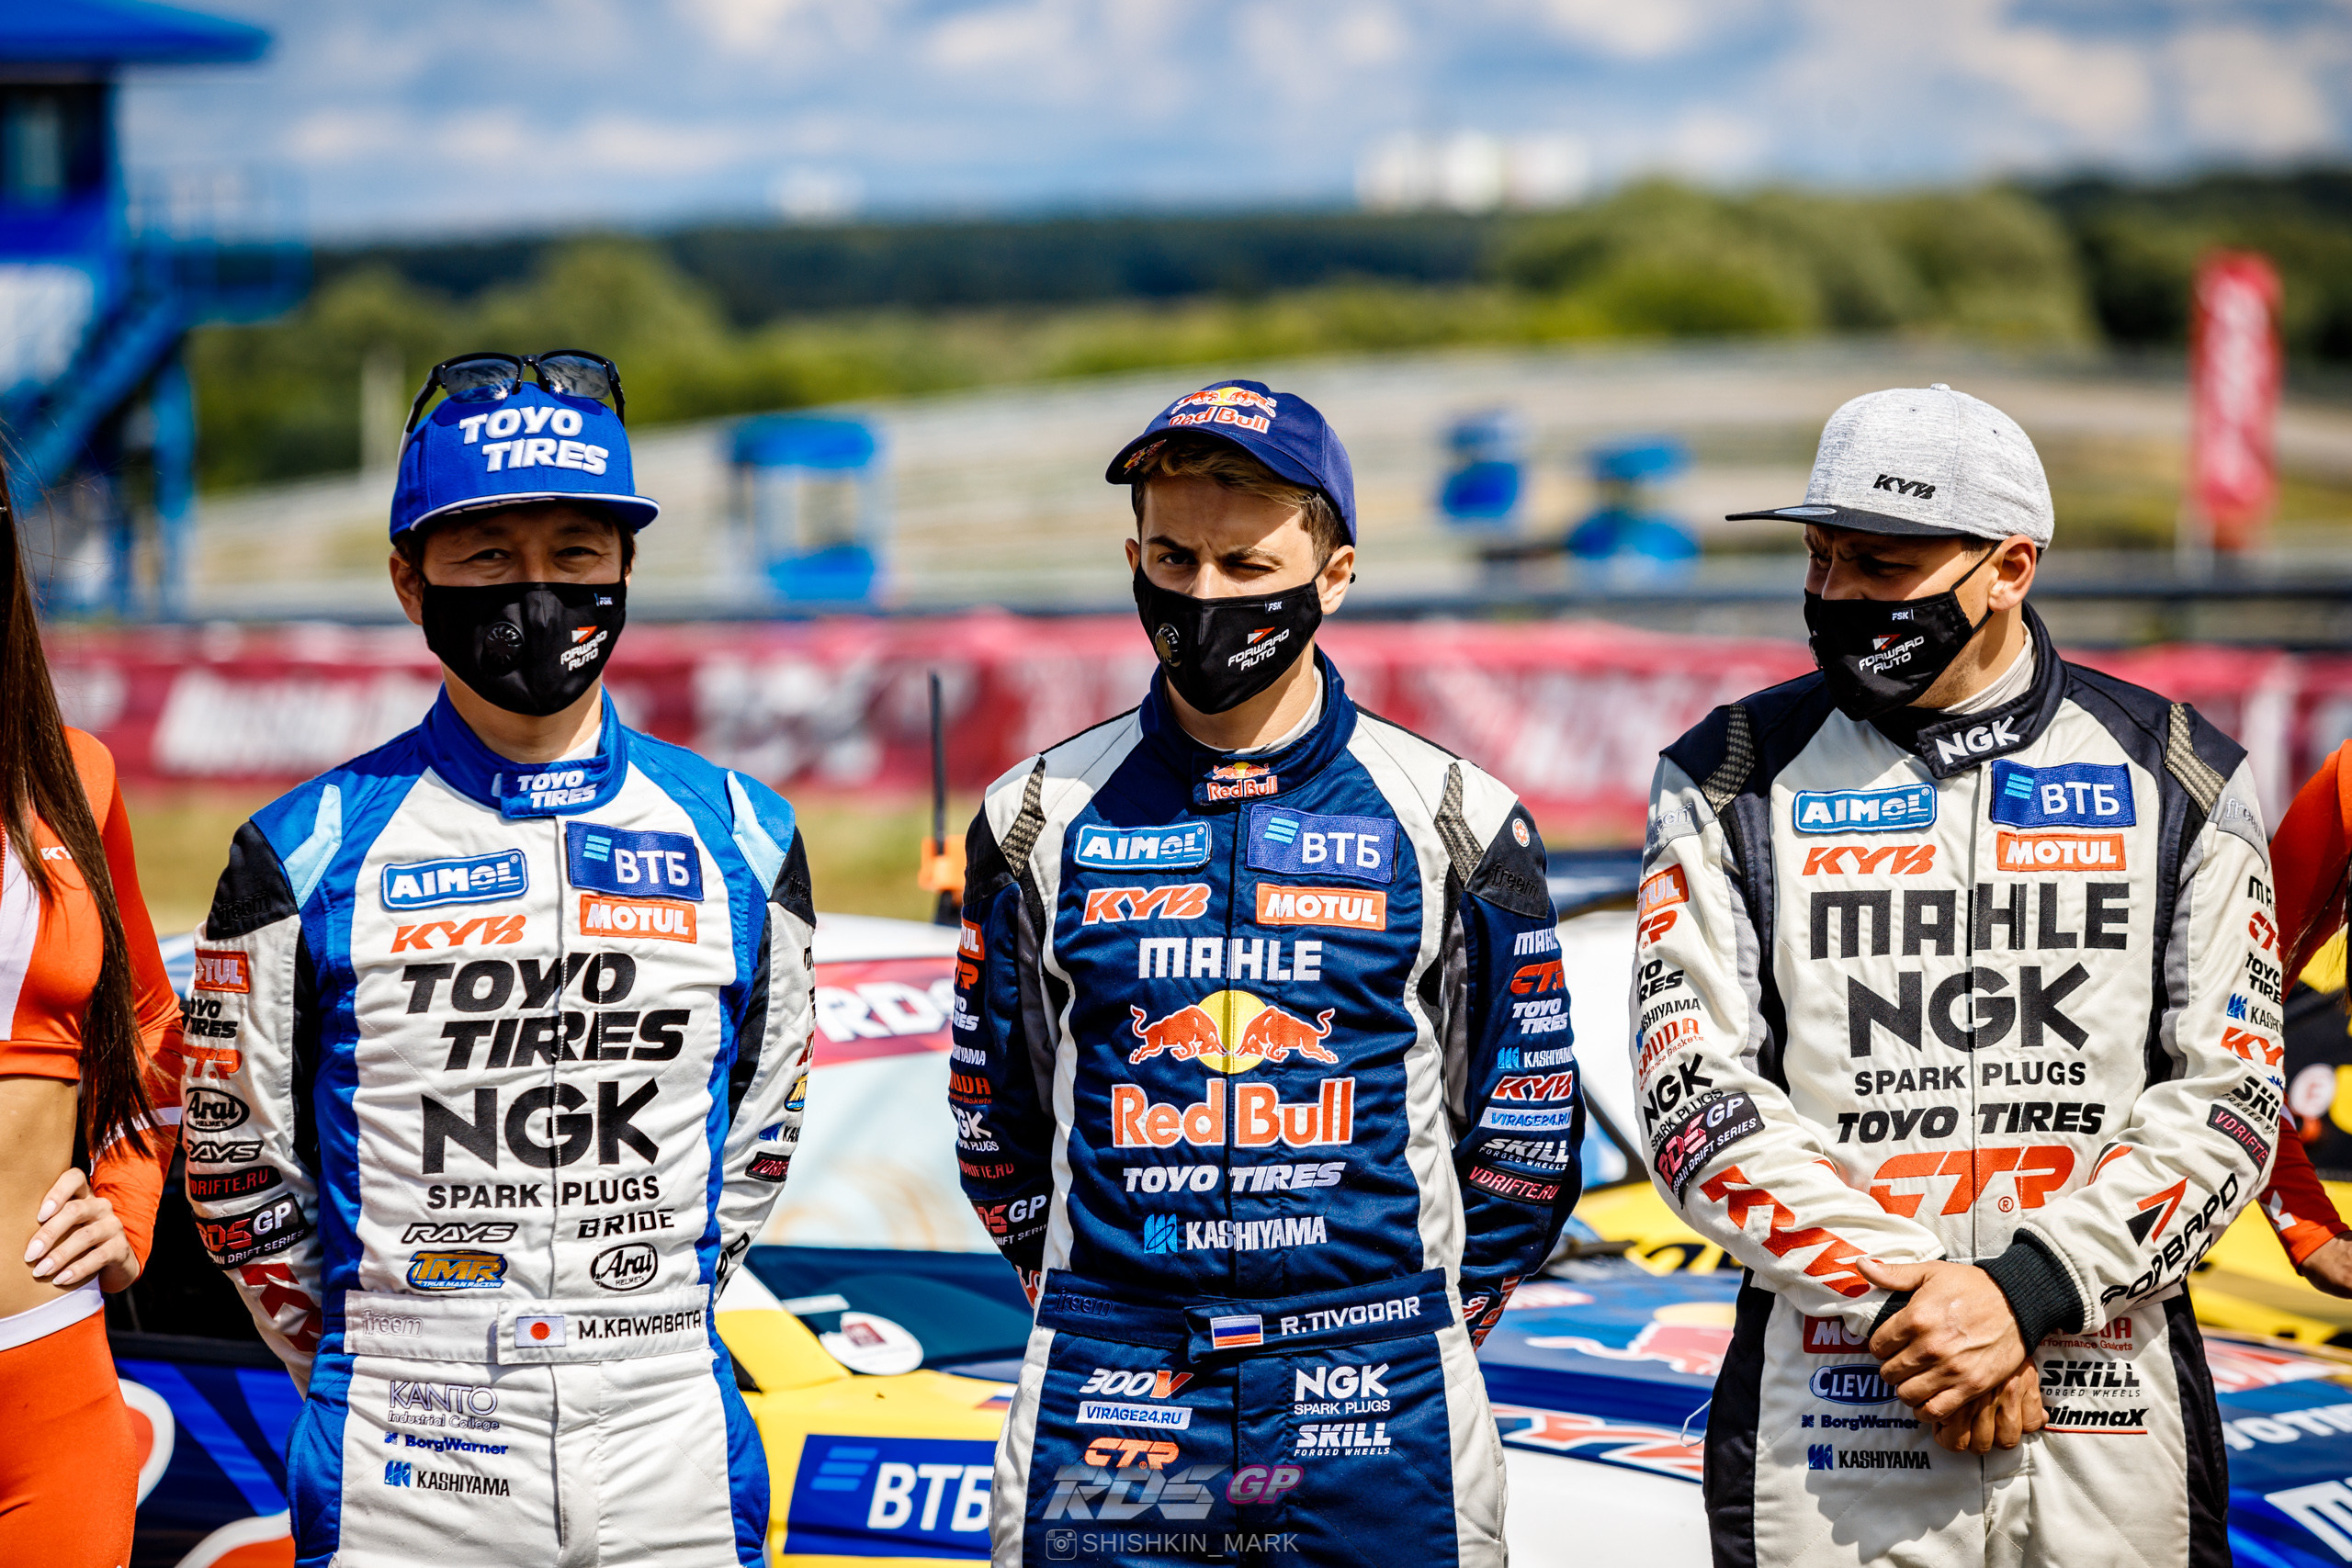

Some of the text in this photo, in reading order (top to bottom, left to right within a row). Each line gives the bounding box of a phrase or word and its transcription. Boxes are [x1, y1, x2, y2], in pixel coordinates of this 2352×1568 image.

[458, 406, 582, 445] TOYO
[1169, 406, 1271, 434] Red Bull
[481, 438, 609, 475] TIRES
[1873, 474, 1936, 500] KYB
[1268, 602, 1282, 612] FSK
[1893, 612, 1908, 620] FSK
[560, 630, 607, 665] FORWARD
[569, 648, 598, 671] AUTO
[1228, 628, 1290, 667] FORWARD
[1241, 646, 1275, 671] AUTO
[1859, 636, 1924, 671] FORWARD
[1873, 652, 1911, 674] AUTO
[1935, 715, 2020, 766] NGK
[517, 770, 584, 791] TOYO
[1207, 775, 1277, 801] Red Bull
[530, 784, 597, 808] TIRES
[1802, 795, 1928, 824] AIMOL
[2042, 782, 2120, 816] ВТБ
[1081, 833, 1203, 861] AIMOL
[1302, 831, 1380, 869] ВТБ
[1803, 844, 1937, 875] KYB
[2007, 841, 2116, 864] MOTUL
[390, 863, 519, 898] AIMOL
[616, 849, 690, 886] ВТБ
[586, 903, 688, 935] MOTUL
[1082, 884, 1212, 926] KYB
[1265, 893, 1377, 922] MOTUL
[390, 915, 526, 953] KYB
[1810, 882, 2130, 960] MAHLE
[1138, 937, 1322, 981] MAHLE
[2245, 952, 2280, 987] TOYO
[401, 953, 636, 1014] TOYO
[1512, 998, 1561, 1018] TOYO
[1521, 1012, 1568, 1034] TIRES
[1848, 962, 2090, 1058] NGK
[440, 1010, 691, 1071] TIRES
[1490, 1070, 1573, 1101] KYB
[1855, 1062, 2086, 1096] SPARK PLUGS
[187, 1092, 239, 1119] Arai
[1643, 1053, 1713, 1139] NGK
[2222, 1093, 2262, 1122] FORGED
[421, 1077, 660, 1175] NGK
[1112, 1077, 1355, 1148] Red Bull
[1491, 1112, 1570, 1126] VIRAGE24.RU
[1707, 1098, 1745, 1128] GP
[1838, 1102, 2105, 1143] TOYO TIRES
[972, 1141, 1000, 1152] PLUGS
[1479, 1146, 1566, 1170] FORGED WHEELS
[1484, 1139, 1569, 1163] SKILL
[1689, 1141, 1715, 1171] DRIFT
[1717, 1118, 1757, 1146] SERIES
[1123, 1162, 1346, 1192] TOYO TIRES
[1469, 1166, 1561, 1200] VDRIFTE.RU
[427, 1176, 660, 1209] SPARK PLUGS
[254, 1201, 292, 1235] GP
[578, 1209, 674, 1239] BRIDE
[1009, 1195, 1046, 1223] GP
[228, 1247, 261, 1263] DRIFT
[265, 1229, 304, 1251] SERIES
[401, 1222, 518, 1244] RAYS
[1186, 1215, 1327, 1251] KASHIYAMA
[414, 1253, 501, 1280] TMR
[600, 1250, 652, 1280] Arai
[578, 1310, 702, 1339] M.KAWABATA
[1281, 1295, 1421, 1337] R.TIVODAR
[1079, 1368, 1193, 1399] 300V
[1295, 1363, 1390, 1402] NGK
[2041, 1360, 2139, 1387] SKILL
[390, 1380, 497, 1416] KANTO
[1294, 1400, 1390, 1416] SPARK PLUGS
[2093, 1389, 2141, 1397] WHEELS
[388, 1410, 500, 1432] Industrial College
[1086, 1405, 1183, 1425] VIRAGE24.RU
[1821, 1415, 1919, 1431] BorgWarner
[405, 1434, 508, 1454] BorgWarner
[1296, 1425, 1392, 1448] SKILL
[1294, 1447, 1390, 1457] FORGED WHEELS
[1838, 1450, 1930, 1469] KASHIYAMA
[417, 1471, 510, 1496] KASHIYAMA
